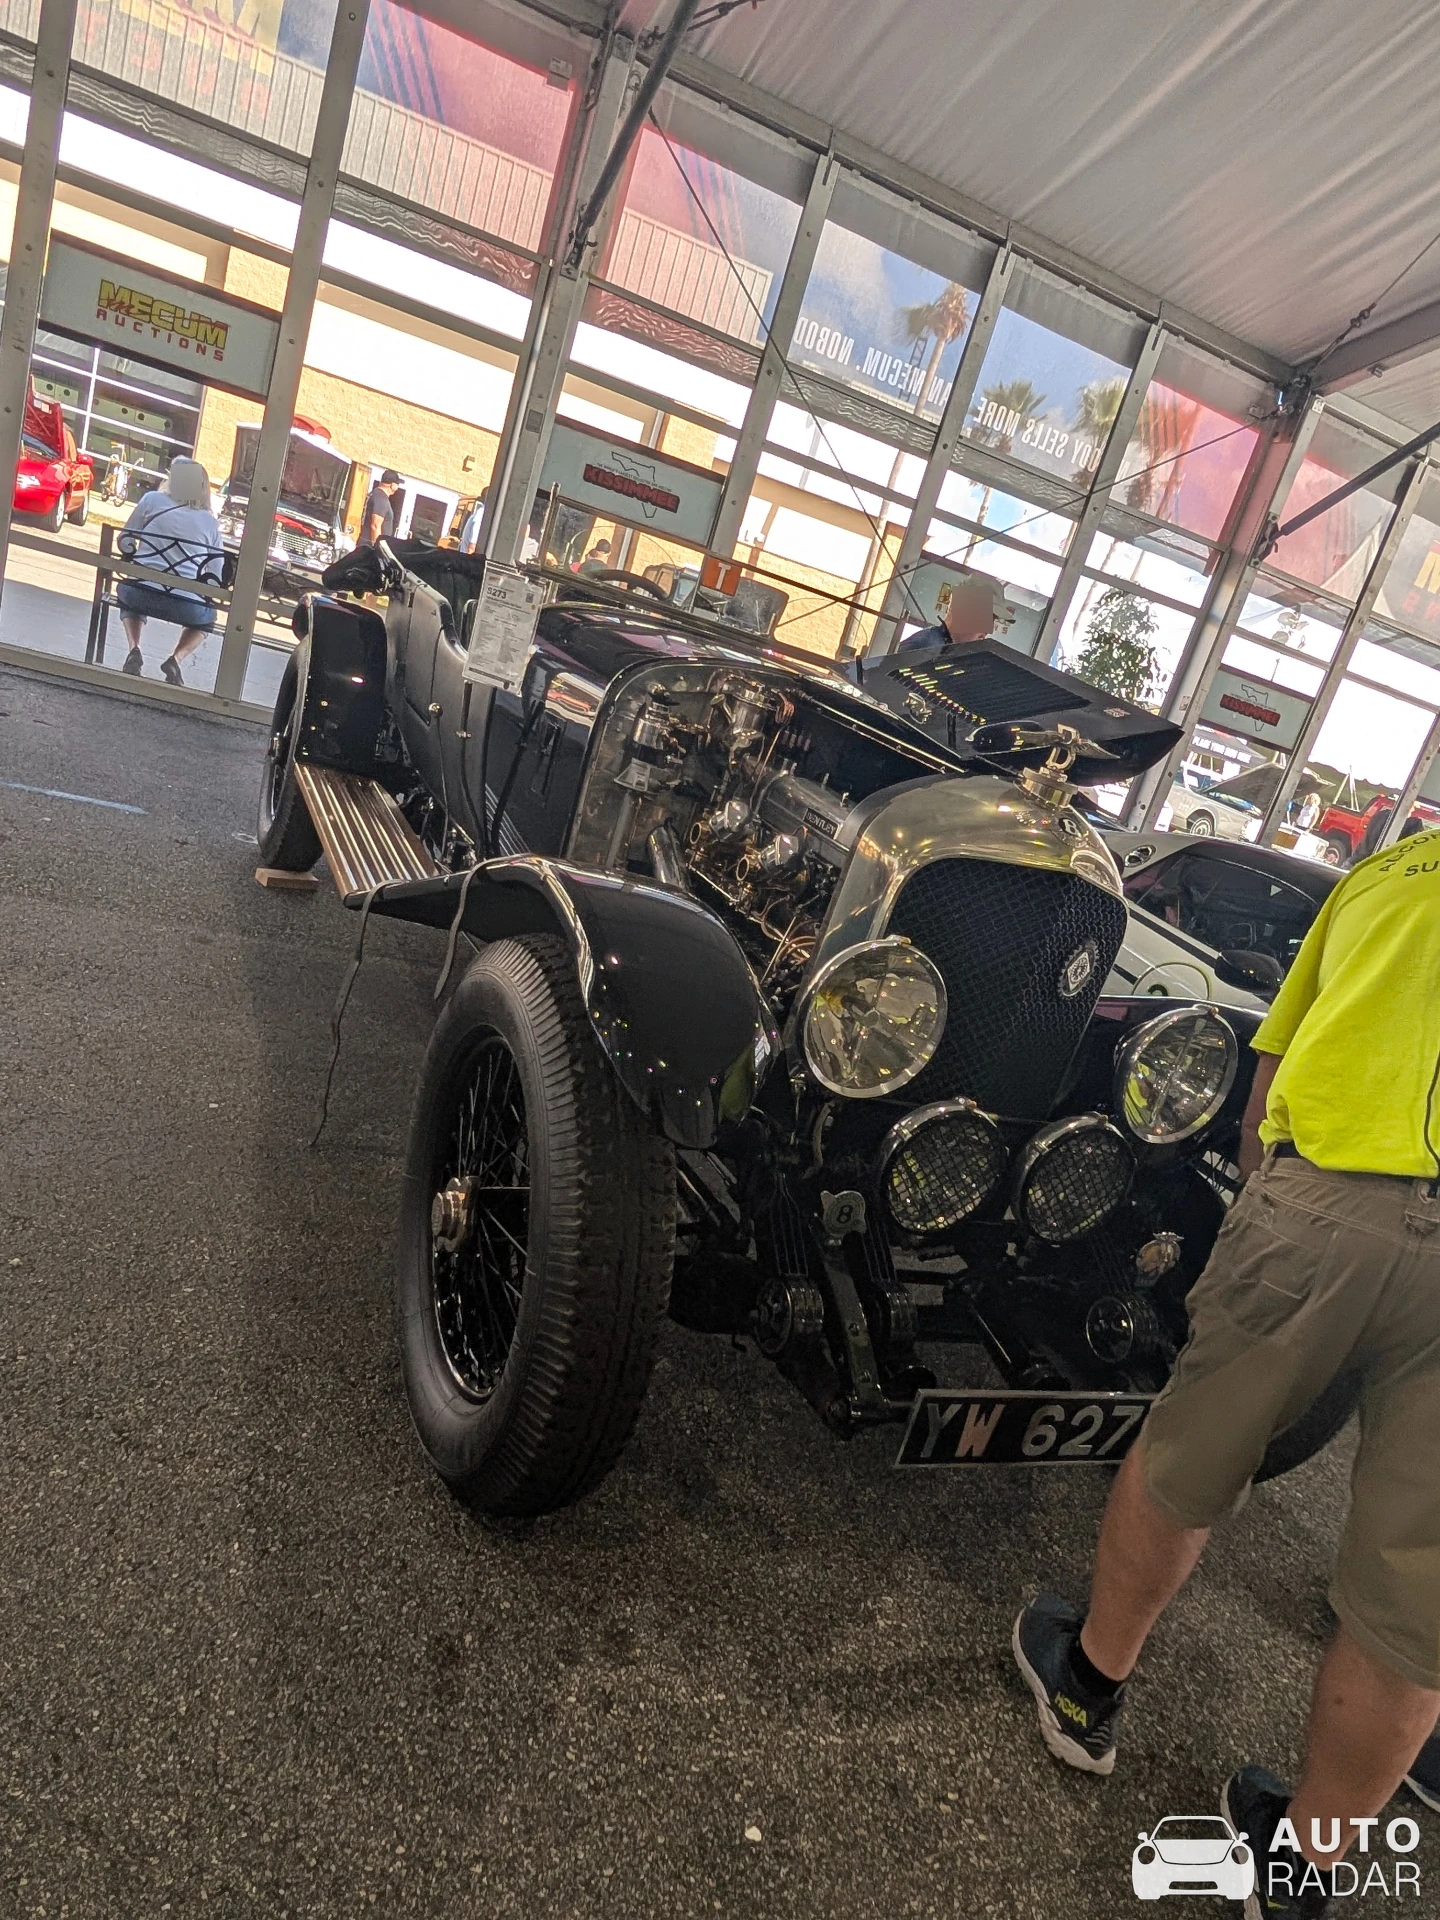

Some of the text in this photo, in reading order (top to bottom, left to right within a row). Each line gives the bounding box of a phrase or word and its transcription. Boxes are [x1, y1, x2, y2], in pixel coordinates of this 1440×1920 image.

[97, 279, 230, 350] MECUM
[96, 308, 225, 363] AUCTIONS
[583, 464, 682, 514] KISSIMMEE
[486, 586, 508, 601] S273
[715, 562, 732, 590] T
[1220, 693, 1281, 728] KISSIMMEE
[805, 812, 837, 835] BENTLEY
[836, 1204, 854, 1224] 8
[919, 1402, 1006, 1459] YW
